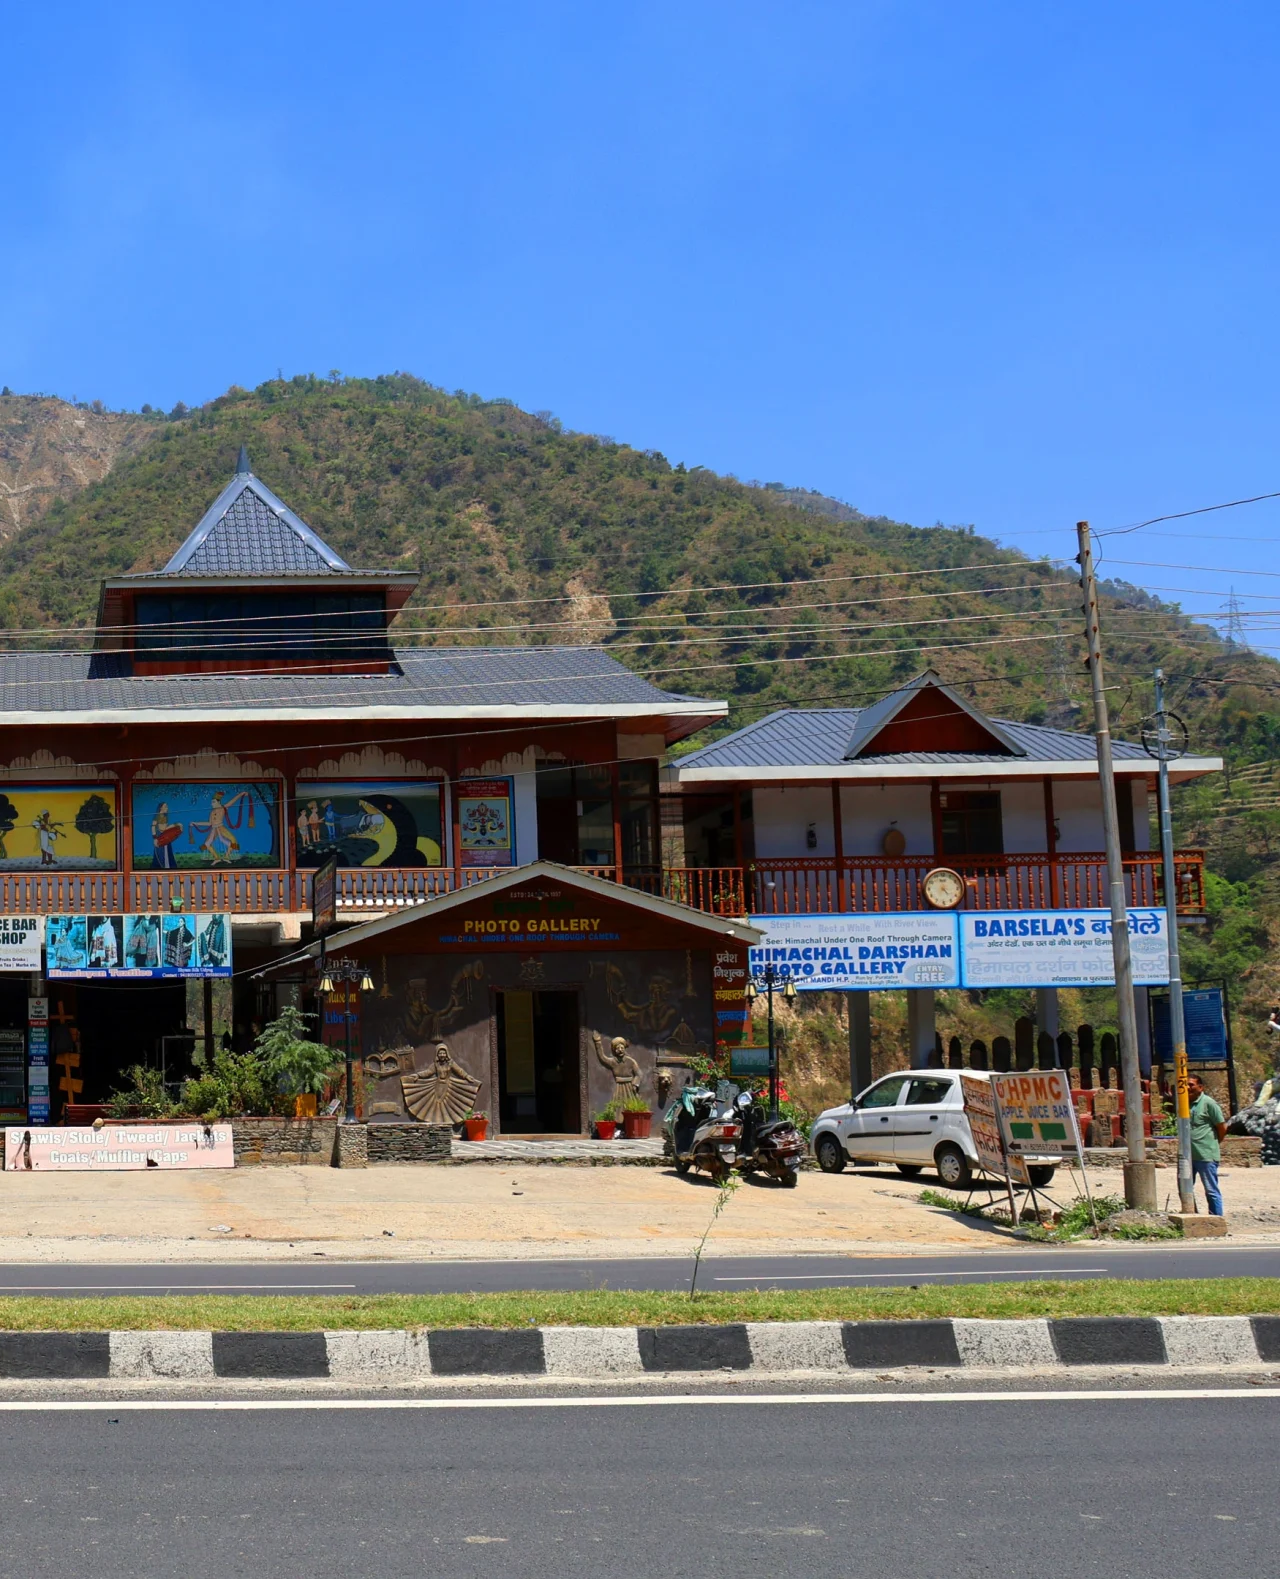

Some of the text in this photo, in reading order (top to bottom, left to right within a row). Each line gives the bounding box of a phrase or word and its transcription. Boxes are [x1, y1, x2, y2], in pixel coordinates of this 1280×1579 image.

[13, 918, 37, 931] BAR
[464, 918, 601, 933] PHOTO GALLERY
[770, 920, 802, 930] Step in
[818, 924, 838, 933] Rest
[846, 923, 871, 933] While
[873, 919, 938, 929] With River View.
[974, 918, 1085, 937] BARSELA'S
[439, 935, 478, 943] HIMACHAL
[481, 934, 506, 942] UNDER
[509, 934, 524, 942] ONE
[550, 933, 586, 941] THROUGH
[785, 936, 822, 945] Himachal
[824, 936, 848, 944] Under
[849, 936, 865, 944] One
[867, 935, 885, 943] Roof
[887, 935, 920, 944] Through
[921, 934, 953, 942] Camera
[716, 950, 738, 965] प्रवेश
[750, 944, 952, 962] HIMACHAL DARSHAN
[48, 967, 153, 979] Himalayan Textiles
[821, 961, 906, 976] GALLERY
[917, 964, 943, 973] ENTRY
[810, 976, 835, 984] MANDI
[914, 972, 946, 983] FREE
[326, 992, 357, 1003] Musem
[1006, 1075, 1062, 1101] HPMC
[1001, 1105, 1025, 1118] APPLE
[1053, 1104, 1071, 1118] BAR
